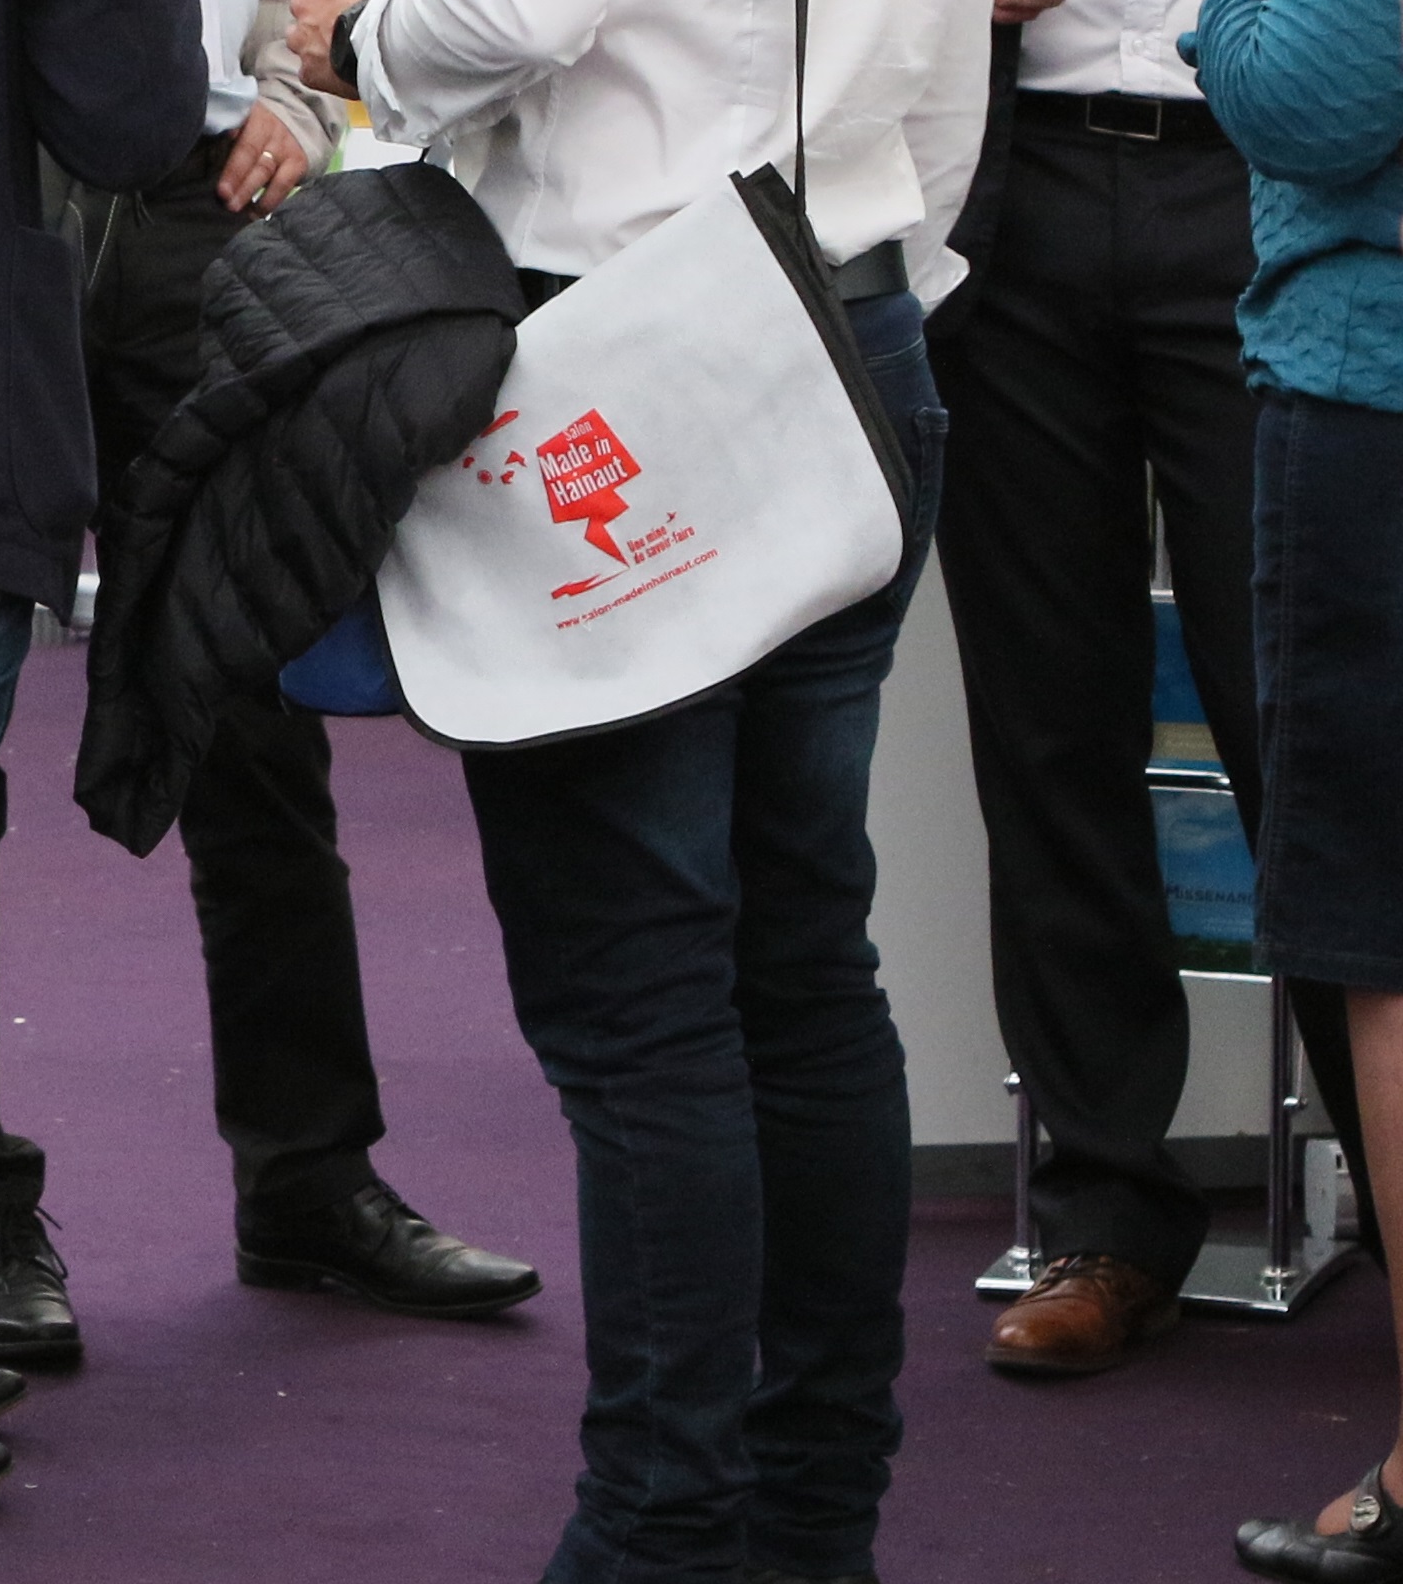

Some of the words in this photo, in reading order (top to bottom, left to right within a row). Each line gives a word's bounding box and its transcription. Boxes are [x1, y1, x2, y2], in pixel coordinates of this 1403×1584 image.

[564, 419, 593, 443] Salon
[540, 440, 594, 482] Made
[595, 434, 612, 458] in
[550, 456, 628, 507] Hainaut
[556, 548, 718, 630] www.salon-madeinhainaut.com
